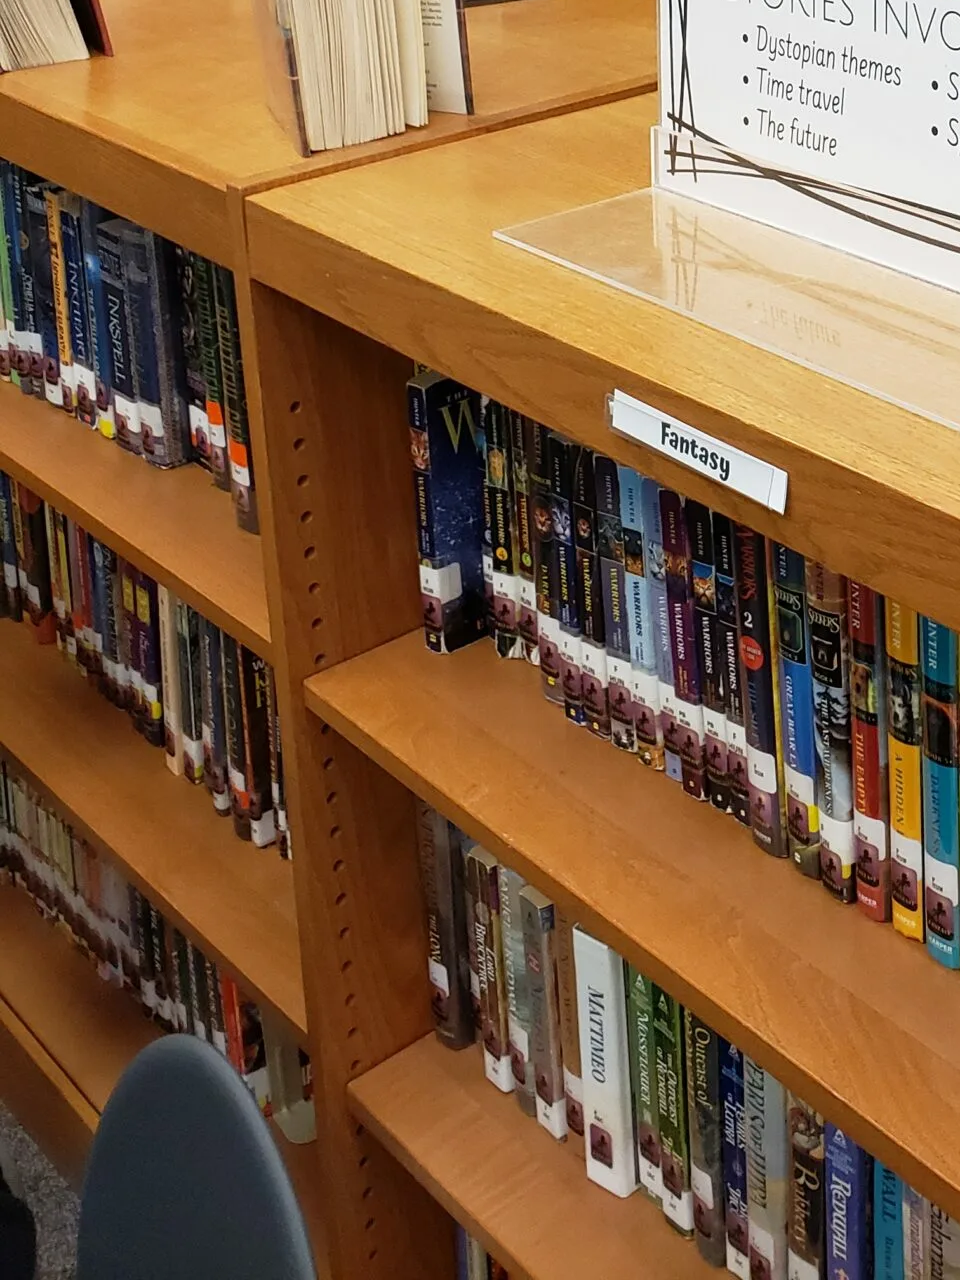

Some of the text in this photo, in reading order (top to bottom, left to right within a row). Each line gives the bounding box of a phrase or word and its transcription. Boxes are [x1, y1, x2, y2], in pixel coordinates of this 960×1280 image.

[756, 25, 902, 86] Dystopian themes
[756, 67, 845, 115] Time travel
[756, 108, 837, 156] The future
[108, 293, 126, 384] INKSPELL
[661, 421, 730, 482] Fantasy
[418, 476, 427, 527] WARRIORS
[559, 547, 568, 601] WARRIORS
[583, 557, 592, 613] WARRIORS
[610, 568, 620, 623] WARRIORS
[632, 581, 644, 637] WARRIORS
[674, 602, 685, 660] WARRIORS
[744, 611, 753, 628] 2
[808, 608, 840, 633] SEEKERS
[851, 583, 861, 630] NTER
[891, 601, 900, 649] NTER
[702, 616, 713, 674] WARRIORS
[726, 631, 738, 690] WARRIORS
[927, 618, 937, 670] NTER
[786, 675, 797, 750] GREAT BEAR
[855, 732, 866, 814] THE EMPTY
[896, 766, 905, 824] HIDDEN
[930, 773, 941, 853] DARKNESS
[587, 985, 606, 1084] MATTIMEO
[745, 1062, 765, 1130] EARLS
[830, 1172, 852, 1261] REDWALL
[881, 1169, 897, 1223] WALL
